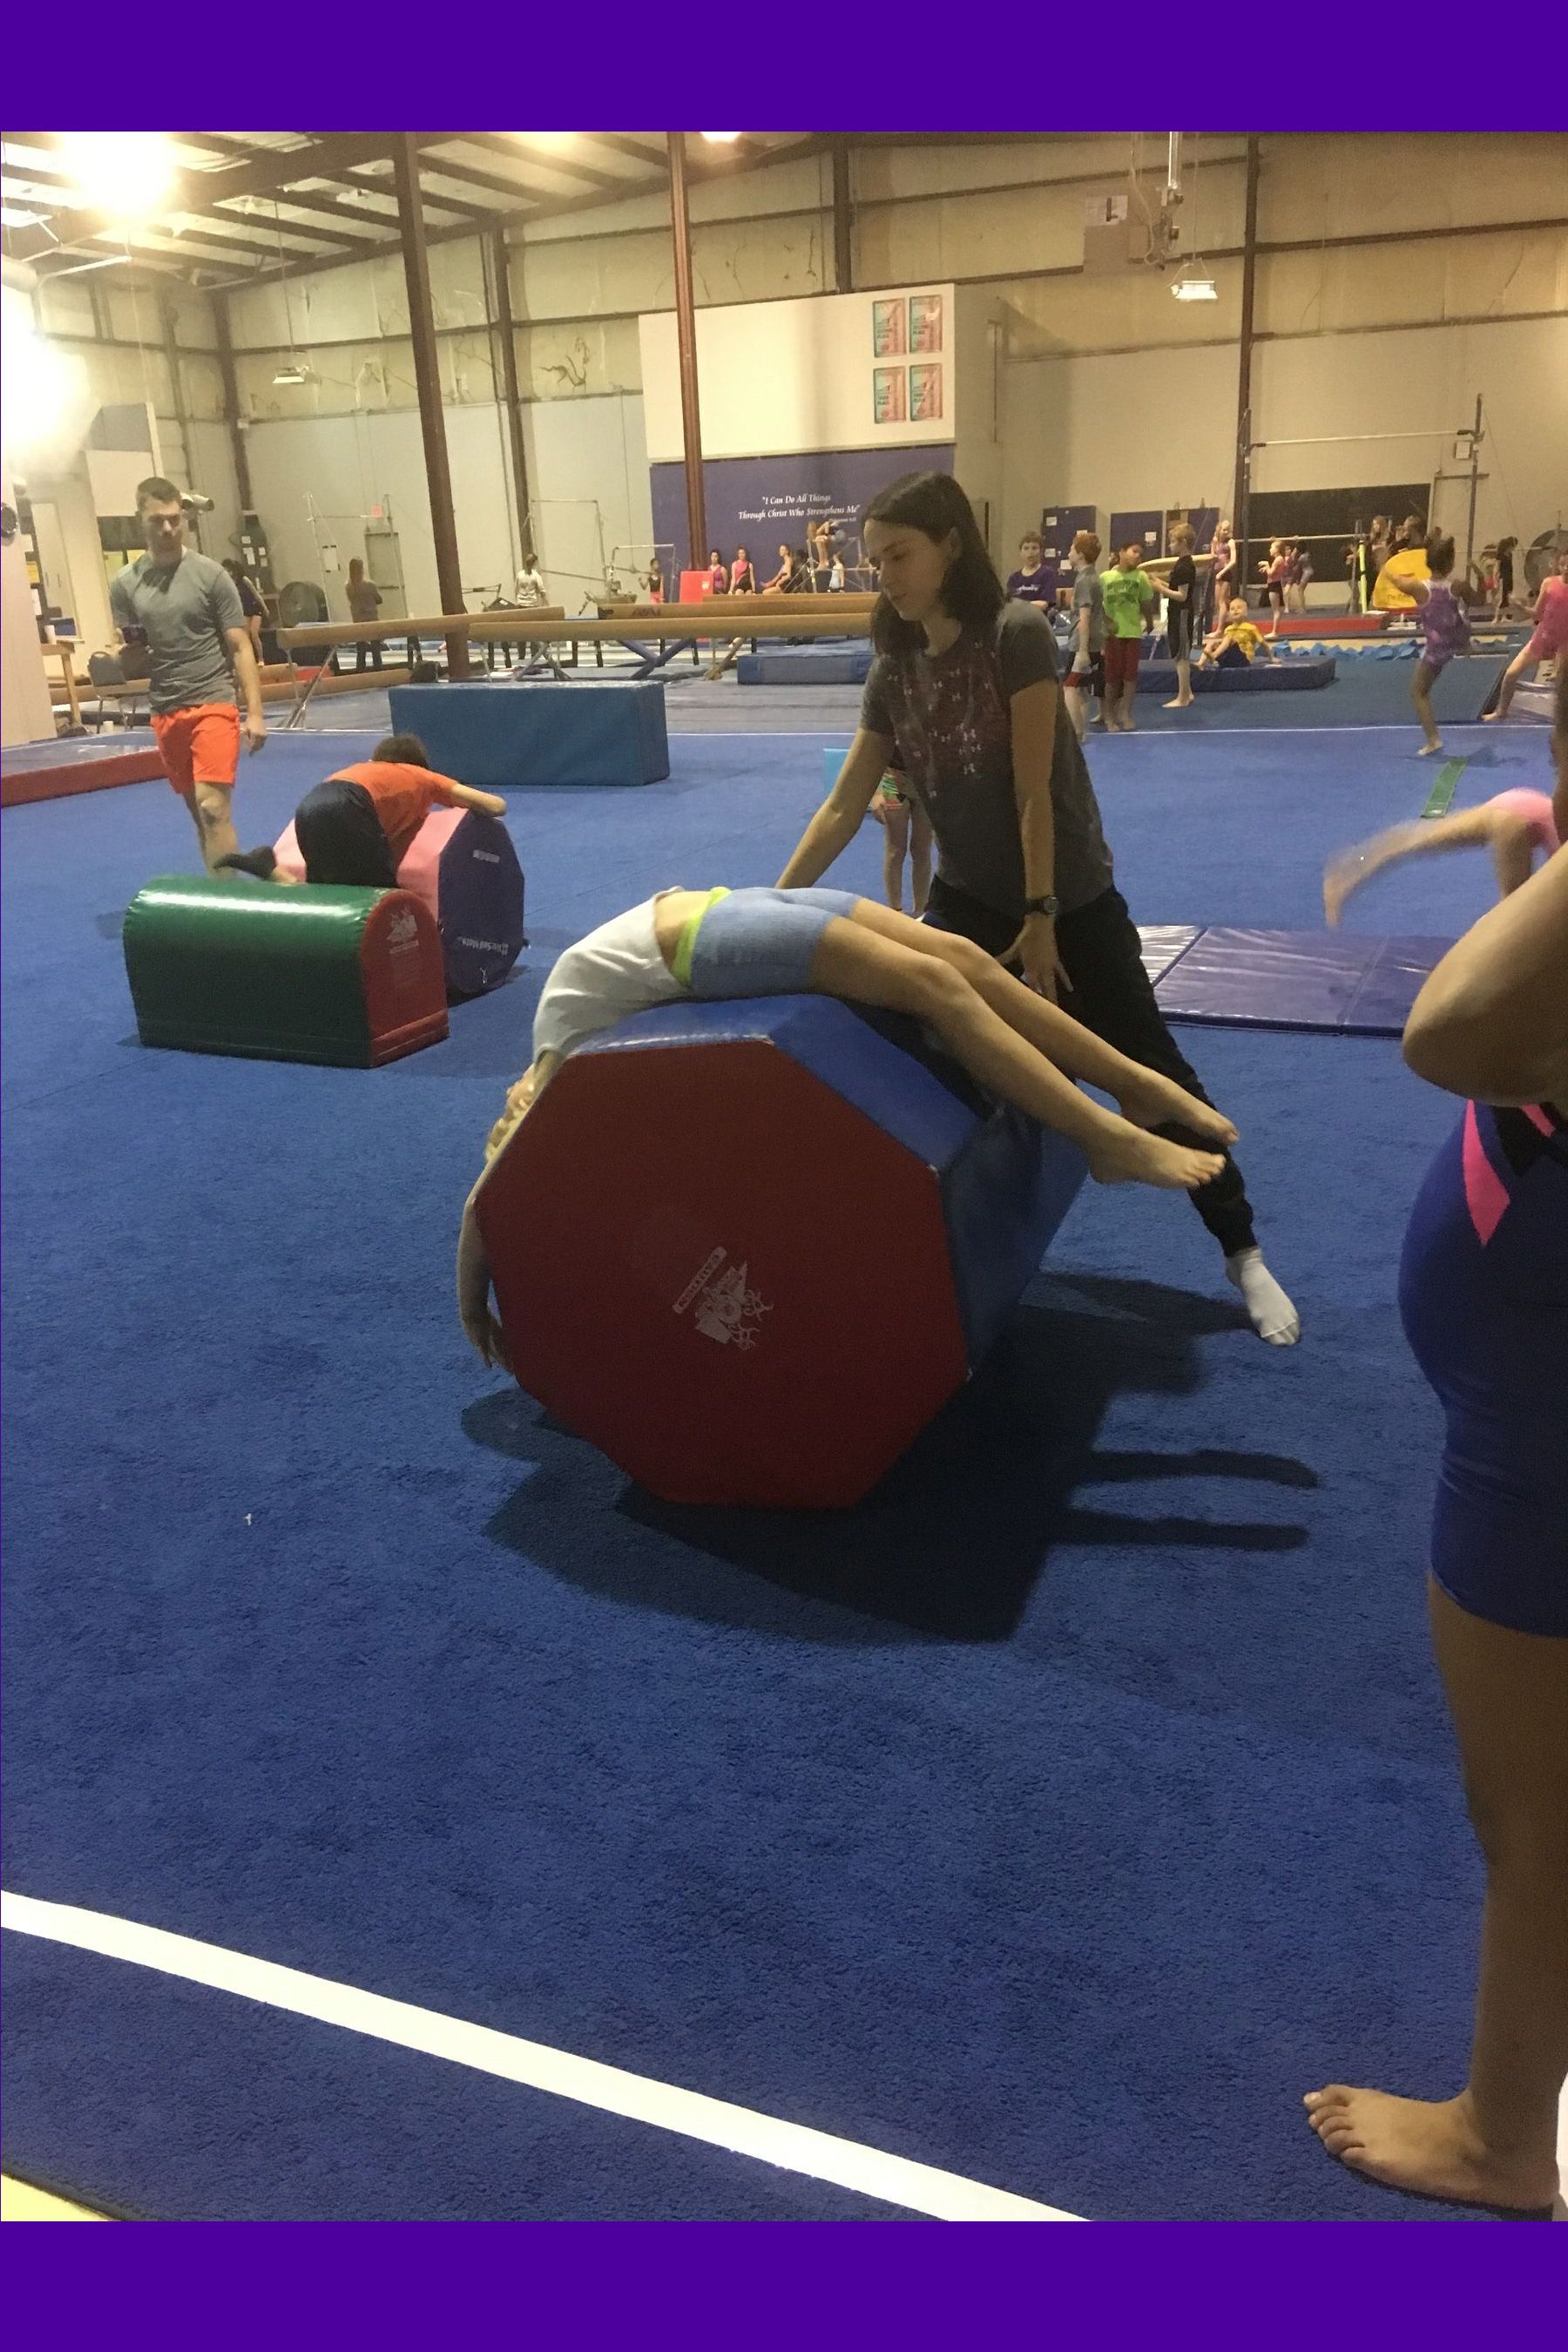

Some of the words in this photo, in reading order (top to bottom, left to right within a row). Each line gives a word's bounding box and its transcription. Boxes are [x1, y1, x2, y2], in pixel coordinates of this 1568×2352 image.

[770, 496, 783, 505] Can
[785, 495, 795, 504] Do
[796, 492, 808, 504] All
[808, 493, 831, 504] Things
[738, 510, 766, 522] Through
[767, 508, 787, 518] Christ
[788, 507, 805, 517] Who
[806, 505, 845, 517] Strengthens
